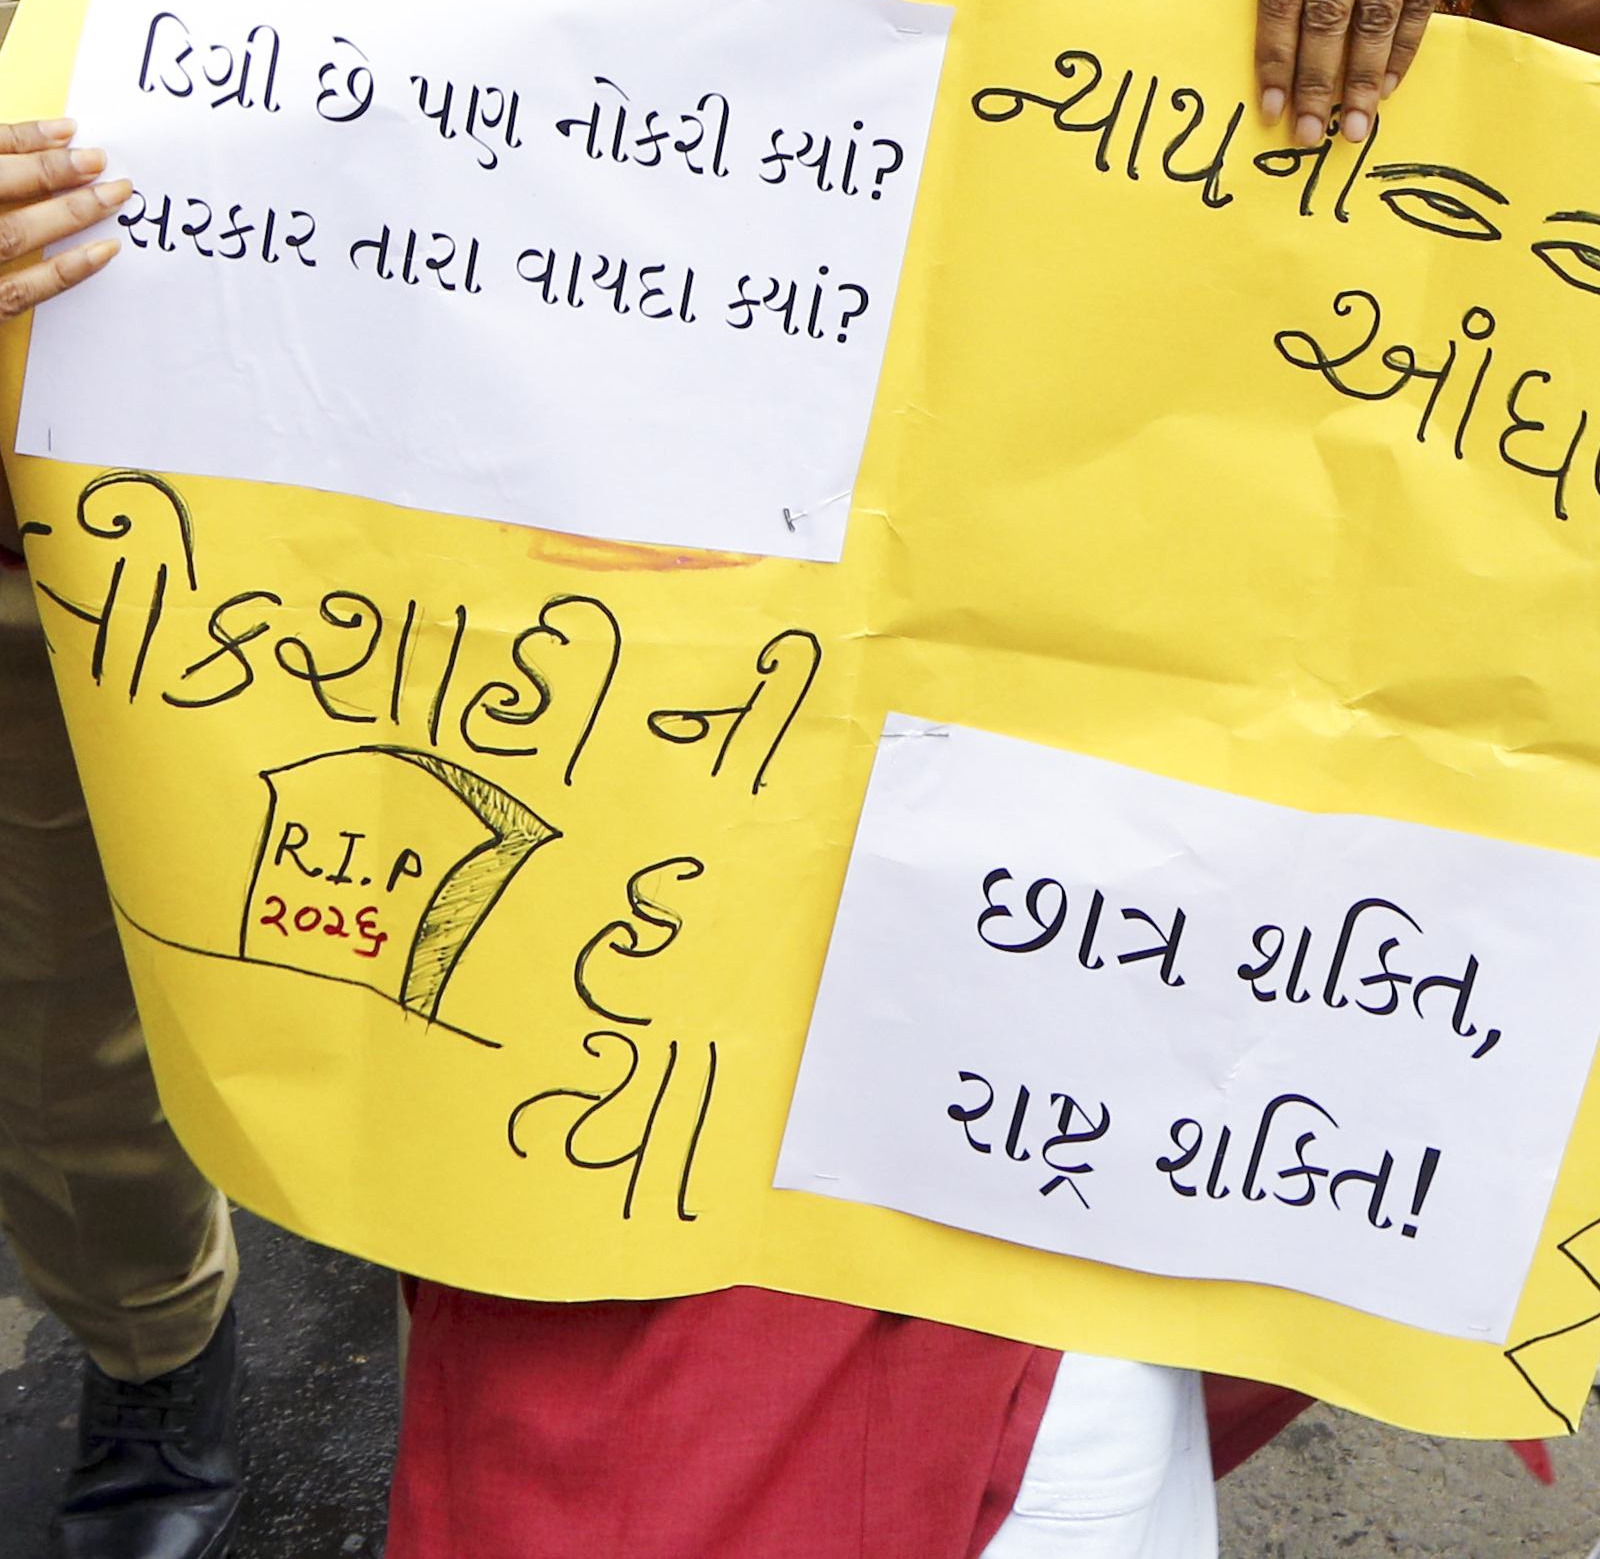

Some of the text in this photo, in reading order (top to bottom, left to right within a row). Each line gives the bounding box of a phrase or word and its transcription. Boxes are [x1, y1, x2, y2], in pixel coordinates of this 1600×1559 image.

[139, 13, 903, 200] ડિગ્રી છે પણ નોકરી ક્યાં?
[118, 195, 868, 343] સરકાર તારા વાયદા ક્યાં?
[978, 868, 1186, 986] છાત્ર
[948, 1072, 1110, 1209] રાષ્ટ્ર
